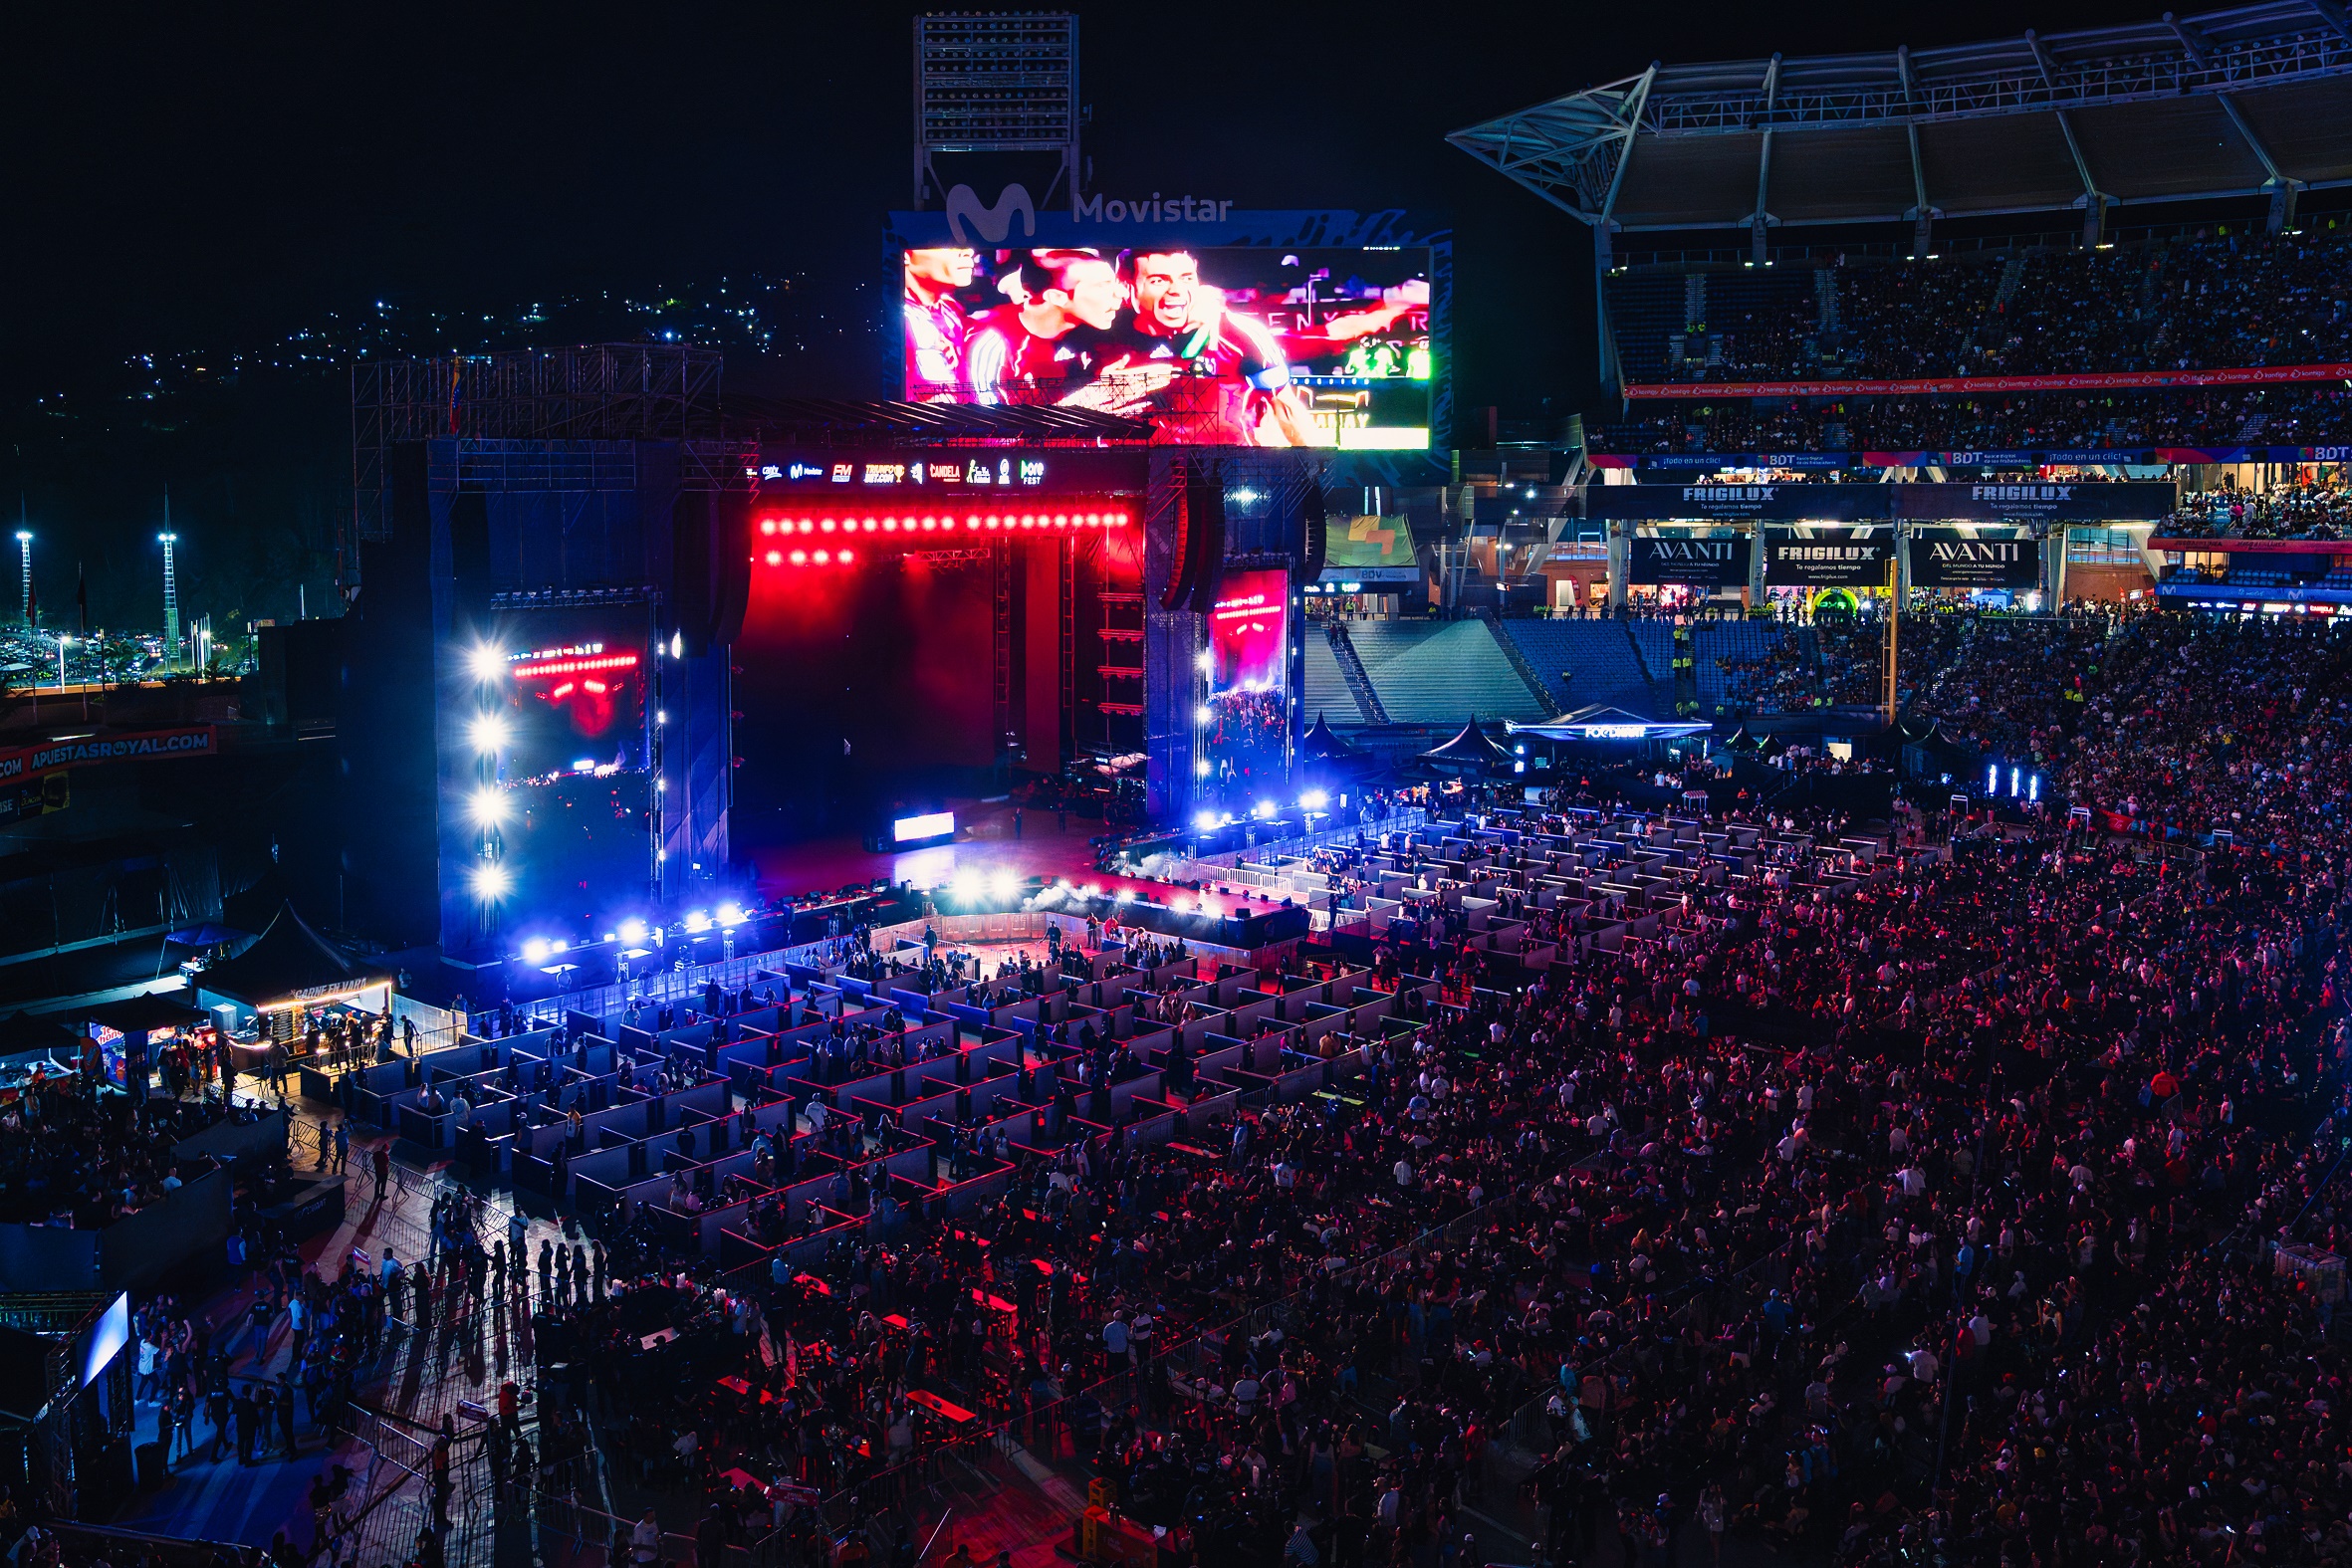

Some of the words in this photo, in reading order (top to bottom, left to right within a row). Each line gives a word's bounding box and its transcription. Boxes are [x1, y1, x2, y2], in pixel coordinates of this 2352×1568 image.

[1073, 192, 1234, 223] Movistar
[1769, 454, 1795, 466] BDT
[1953, 452, 1983, 465] BDT
[2049, 453, 2073, 462] ¡Todo
[2315, 446, 2350, 460] BDT
[833, 464, 852, 476] FM
[929, 464, 960, 478] CANDELA
[1683, 487, 1774, 501] FRIGILUX
[1972, 486, 2072, 501] FRIGILUX
[1649, 542, 1733, 560] AVANTI
[1777, 547, 1875, 560] FRIGILUX
[1929, 543, 2018, 561] AVANTI
[31, 733, 209, 772] APUESTASROYAL.COM
[294, 985, 328, 1000] CARNE
[341, 977, 367, 992] VARA
